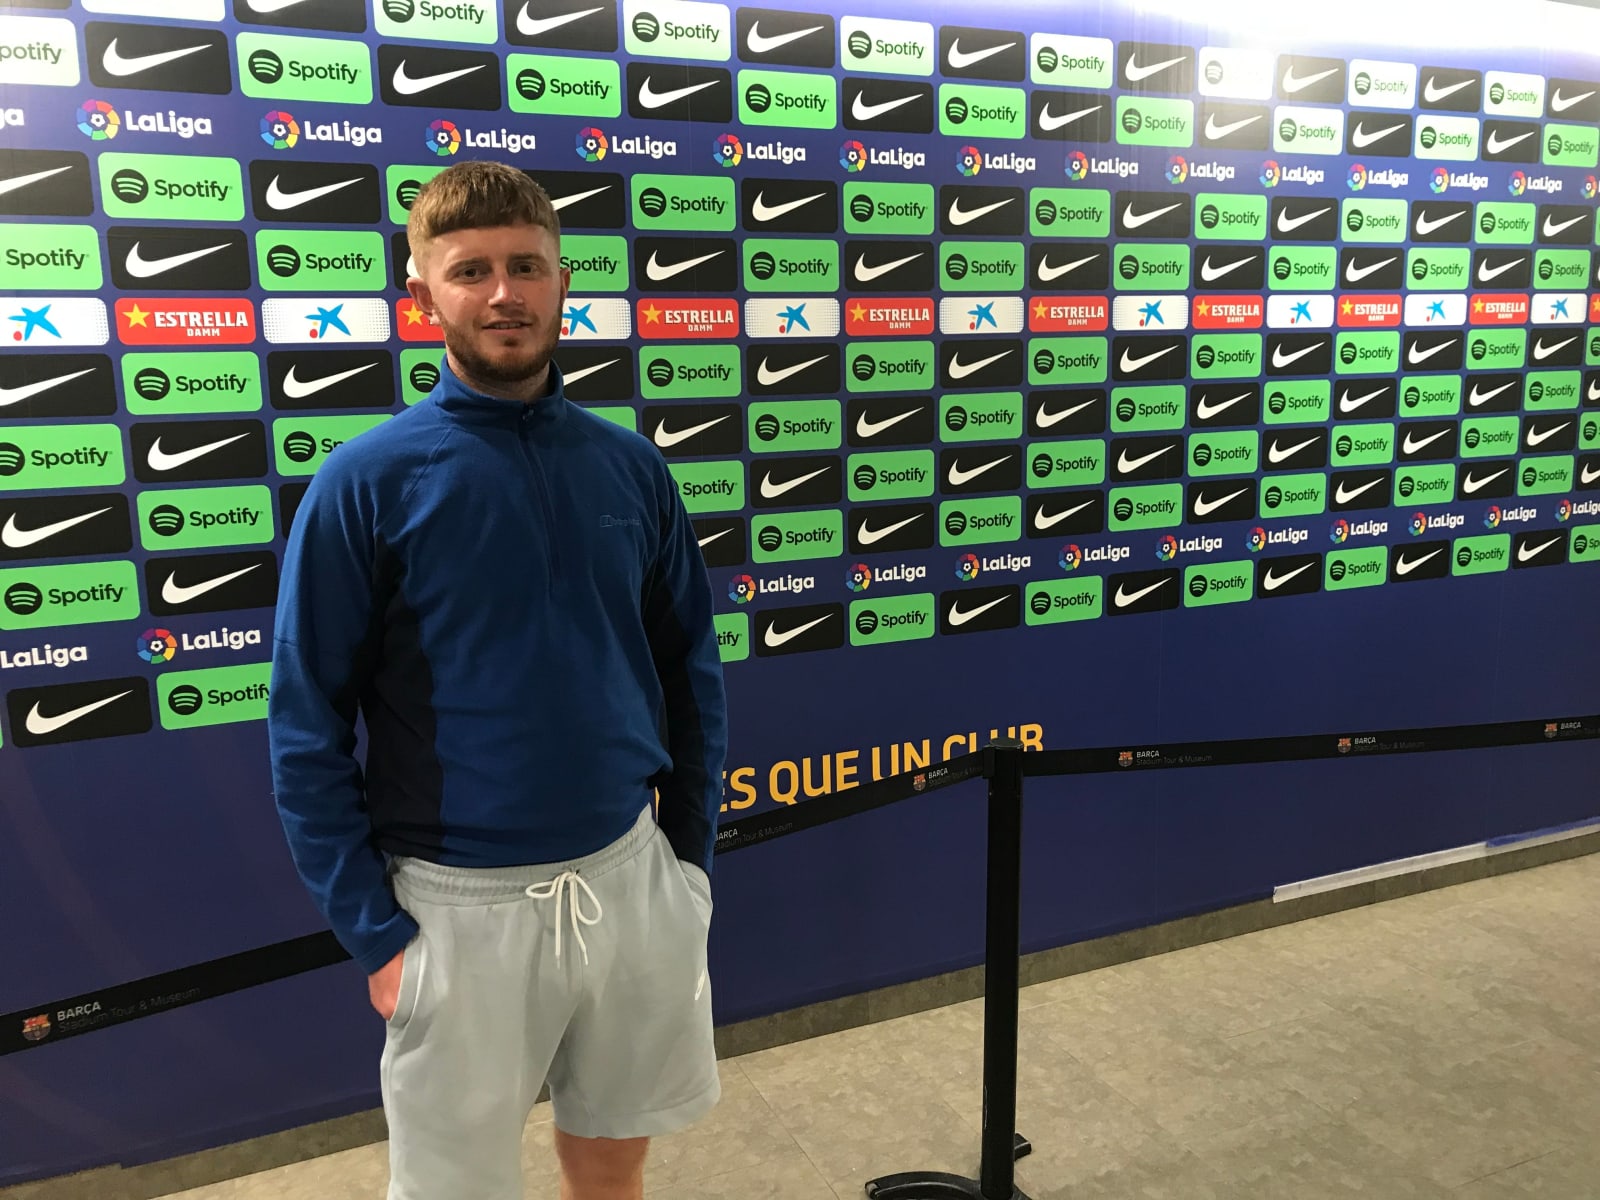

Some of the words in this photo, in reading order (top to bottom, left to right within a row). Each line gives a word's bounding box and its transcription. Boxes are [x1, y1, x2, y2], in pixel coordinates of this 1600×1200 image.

[420, 1, 484, 24] Spotify
[665, 22, 719, 42] Spotify
[0, 43, 61, 64] potify
[876, 40, 924, 58] Spotify
[1062, 55, 1104, 72] Spotify
[289, 61, 357, 84] Spotify
[551, 79, 609, 99] Spotify
[1507, 90, 1537, 104] Spotify
[776, 93, 826, 112] Spotify
[972, 105, 1016, 123] Spotify
[125, 111, 212, 138] LaLiga
[1145, 116, 1185, 132] Spotify
[305, 121, 381, 146] LaLiga
[1300, 125, 1335, 140] Spotify
[1439, 133, 1472, 147] Spotify
[466, 129, 535, 153] LaLiga
[613, 136, 676, 159] LaLiga
[1564, 141, 1594, 155] Spotify
[747, 142, 805, 164] LaLiga
[871, 148, 925, 169] LaLiga
[985, 153, 1035, 173] LaLiga
[1092, 158, 1138, 177] LaLiga
[1191, 162, 1234, 181] LaLiga
[1282, 166, 1324, 185] LaLiga
[1368, 169, 1408, 188] LaLiga
[1450, 173, 1488, 190] LaLiga
[1527, 176, 1562, 193] LaLiga
[155, 180, 228, 201] Spotify
[671, 196, 725, 214] Spotify
[878, 203, 925, 219] Spotify
[1060, 206, 1102, 222] Spotify
[1222, 211, 1259, 226] Spotify
[1366, 216, 1400, 229] Spotify
[1498, 218, 1529, 231] Spotify
[6, 248, 85, 269] Spotify
[306, 253, 372, 272] Spotify
[560, 257, 617, 274] Spotify
[780, 259, 829, 276] Spotify
[971, 260, 1016, 276] Spotify
[1142, 261, 1182, 276] Spotify
[1294, 263, 1329, 276] Spotify
[1430, 264, 1463, 276] Spotify
[1555, 264, 1584, 277] Spotify
[665, 310, 733, 323] ESTRELLA
[870, 309, 929, 321] ESTRELLA
[1051, 306, 1104, 318] ESTRELLA
[1212, 305, 1259, 318] ESTRELLA
[1355, 304, 1398, 316] ESTRELLA
[1486, 303, 1525, 315] ESTRELLA
[155, 312, 248, 327] ESTRELLA
[889, 321, 911, 329] DAMM
[1067, 318, 1088, 326] DAMM
[186, 328, 220, 337] DAMM
[687, 324, 713, 332] DAMM
[1218, 350, 1254, 364] Spotify
[1359, 347, 1392, 360] Spotify
[1489, 343, 1520, 357] Spotify
[879, 359, 925, 376] Spotify
[1058, 354, 1099, 370] Spotify
[678, 364, 731, 382] Spotify
[176, 374, 247, 394] Spotify
[1546, 385, 1575, 398] Spotify
[1289, 396, 1324, 410] Spotify
[1422, 390, 1455, 403] Spotify
[971, 409, 1014, 426] Spotify
[1139, 402, 1178, 417] Spotify
[784, 418, 832, 435] Spotify
[1355, 439, 1387, 452] Spotify
[1482, 431, 1513, 444] Spotify
[31, 447, 108, 469] Spotify
[1214, 447, 1251, 461] Spotify
[1056, 456, 1097, 472] Spotify
[880, 468, 926, 485] Spotify
[1539, 470, 1568, 482] Spotify
[683, 480, 734, 498] Spotify
[1417, 479, 1448, 492] Spotify
[1285, 489, 1320, 503] Spotify
[1136, 500, 1175, 515] Spotify
[1503, 507, 1536, 521] LaLiga
[190, 508, 259, 529] Spotify
[970, 513, 1013, 530] Spotify
[1428, 513, 1464, 528] LaLiga
[1269, 528, 1307, 544] LaLiga
[1351, 520, 1387, 536] LaLiga
[786, 528, 834, 545] Spotify
[1180, 536, 1222, 552] LaLiga
[1085, 545, 1129, 561] LaLiga
[1474, 548, 1504, 561] Spotify
[983, 554, 1030, 571] LaLiga
[1348, 561, 1381, 576] Spotify
[875, 564, 925, 581] LaLiga
[760, 575, 814, 593] LaLiga
[1210, 576, 1246, 591] Spotify
[49, 584, 123, 606] Spotify
[1054, 593, 1096, 609] Spotify
[881, 611, 928, 628] Spotify
[182, 628, 260, 650] LaLiga
[717, 631, 740, 646] tify
[0, 644, 87, 668] LaLiga
[1354, 736, 1377, 745] BARÇA
[1136, 750, 1160, 758] BARÇA
[1136, 757, 1163, 766] Stadium
[1164, 755, 1177, 764] Tour
[1184, 754, 1213, 763] Museum
[769, 750, 859, 805] QUE
[871, 739, 930, 781] UN
[943, 723, 1043, 761] CB
[928, 767, 949, 780] BARÇA
[743, 831, 758, 841] Tour
[758, 830, 764, 838] &
[764, 822, 793, 836] Museum
[56, 1001, 102, 1022] BARÇA
[58, 1012, 109, 1033] Stadium
[110, 1004, 136, 1017] Tour
[138, 1000, 148, 1010] &
[150, 986, 201, 1007] Museum
